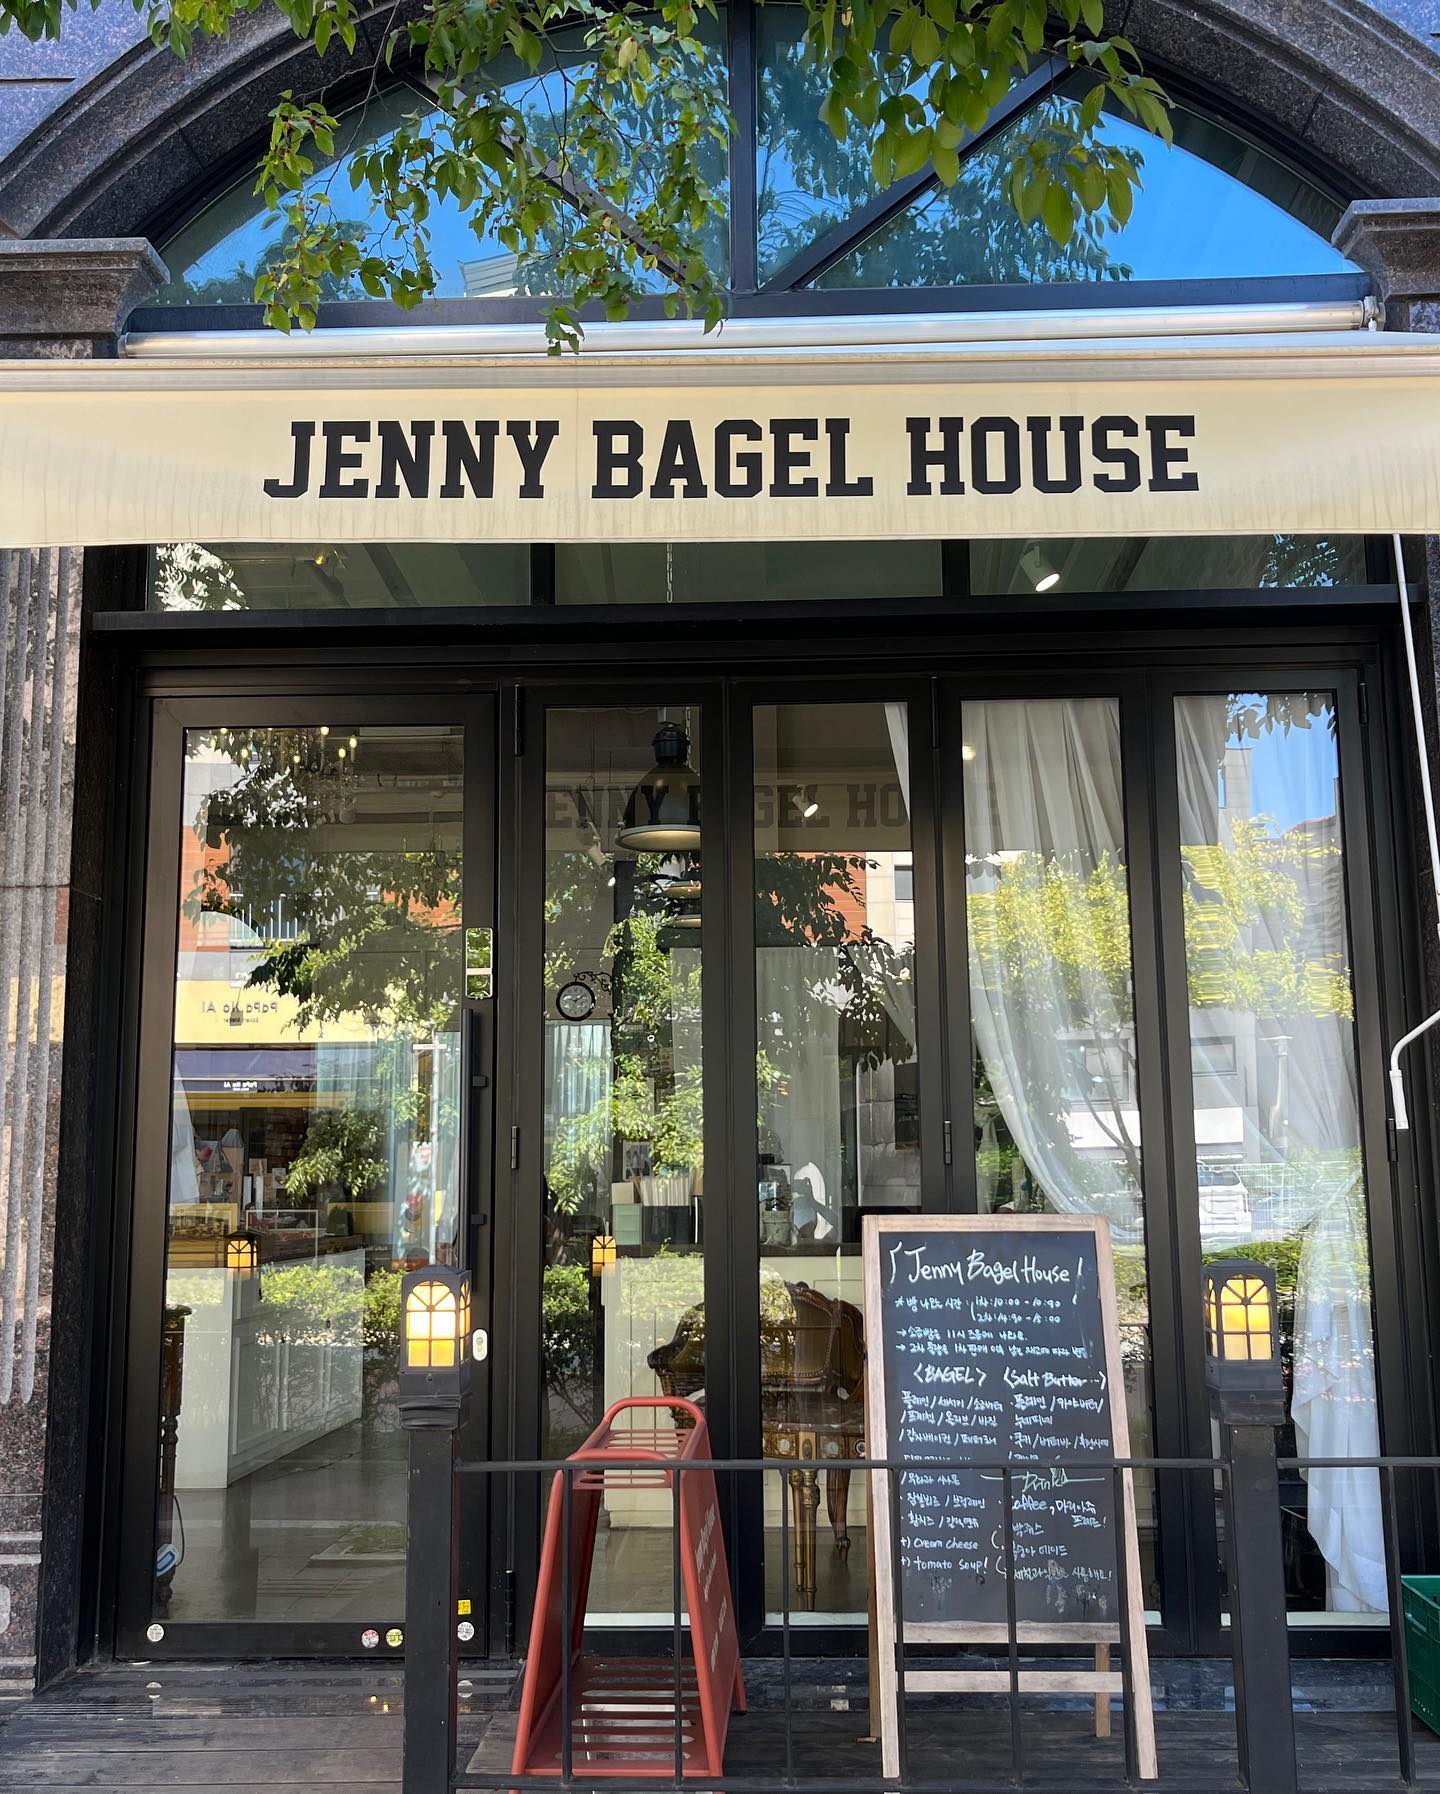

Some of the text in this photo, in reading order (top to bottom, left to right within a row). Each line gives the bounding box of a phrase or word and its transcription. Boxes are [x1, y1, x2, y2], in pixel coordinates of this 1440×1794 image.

[263, 415, 1200, 499] JENNY BAGEL HOUSE
[904, 1246, 1070, 1285] Jenny Bagel House
